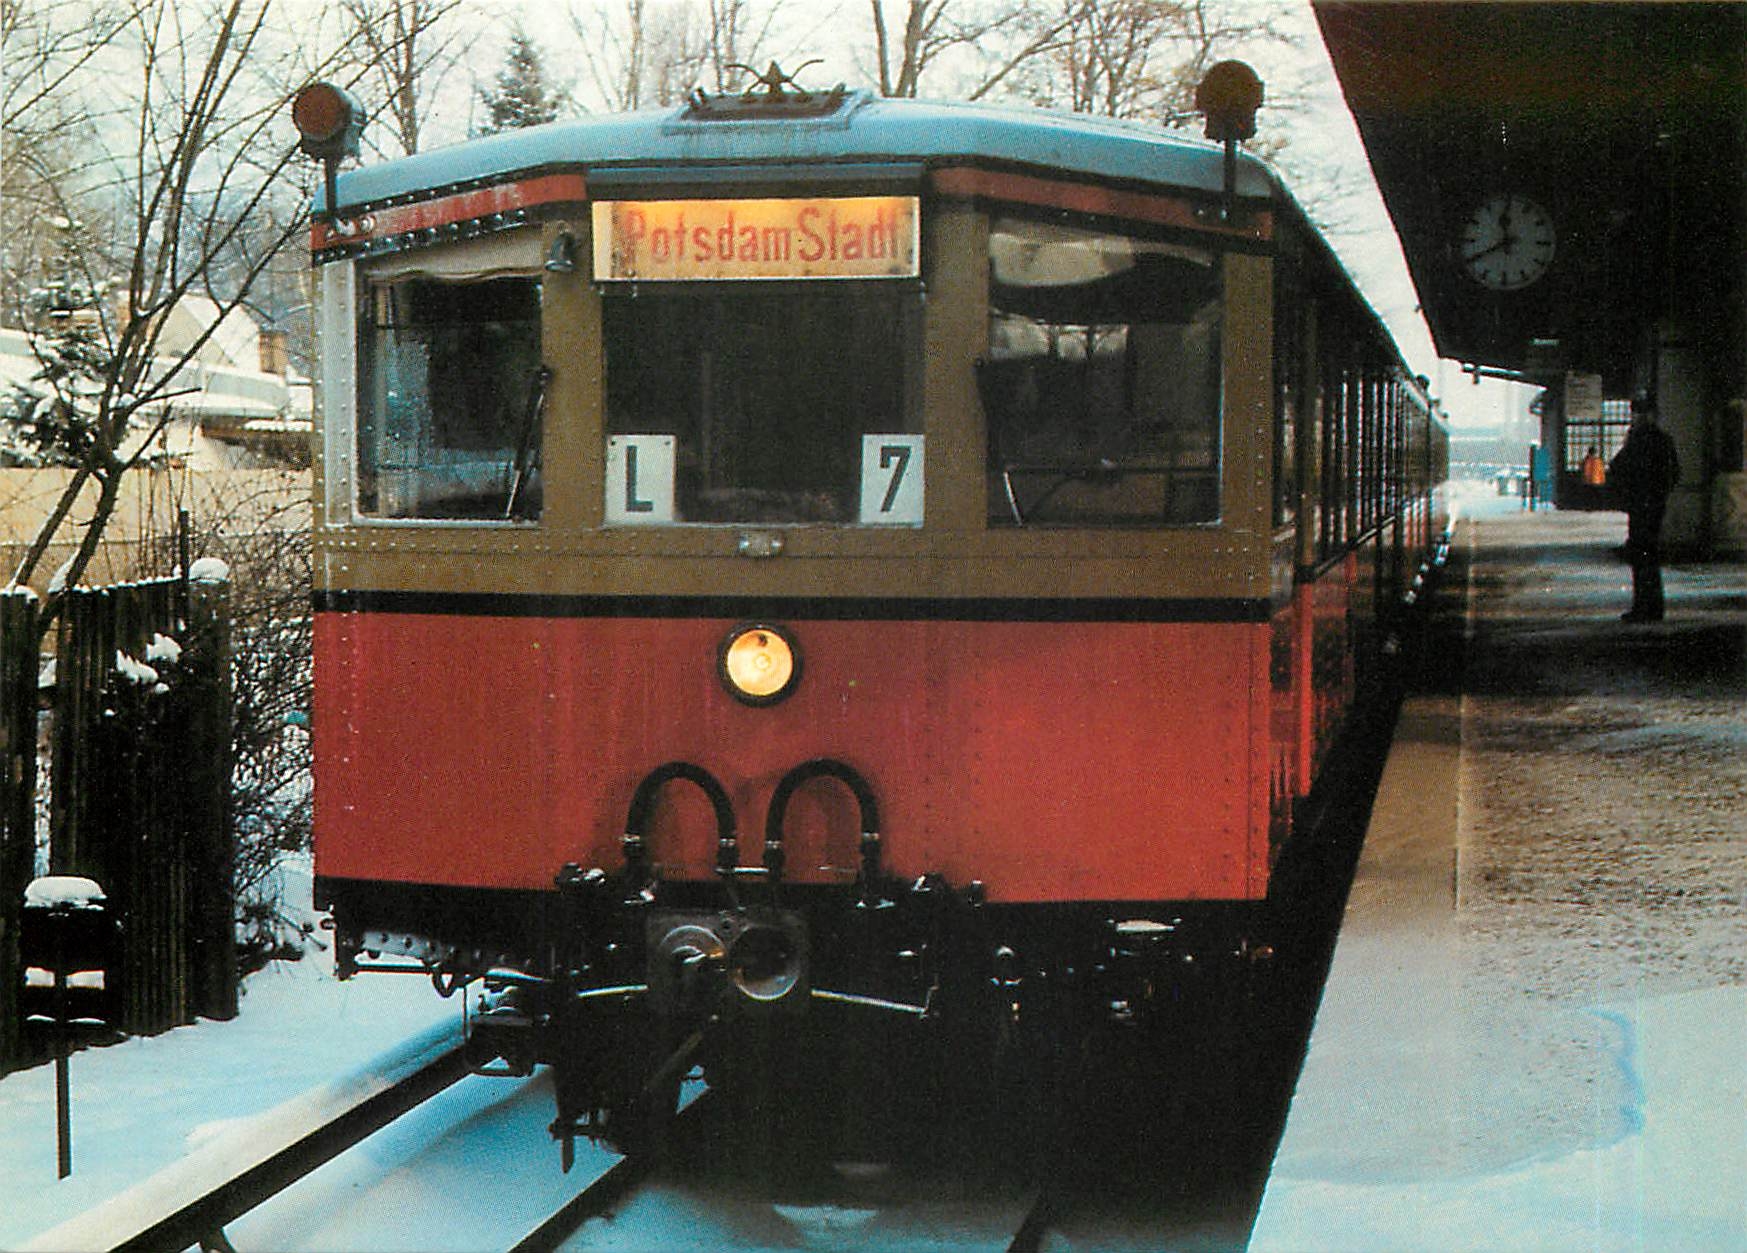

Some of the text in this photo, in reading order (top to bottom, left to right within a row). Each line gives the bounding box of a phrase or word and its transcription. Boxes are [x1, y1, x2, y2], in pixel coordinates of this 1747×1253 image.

[621, 205, 898, 262] Potsdam Stadt
[626, 445, 654, 512] L
[880, 445, 912, 512] 7
